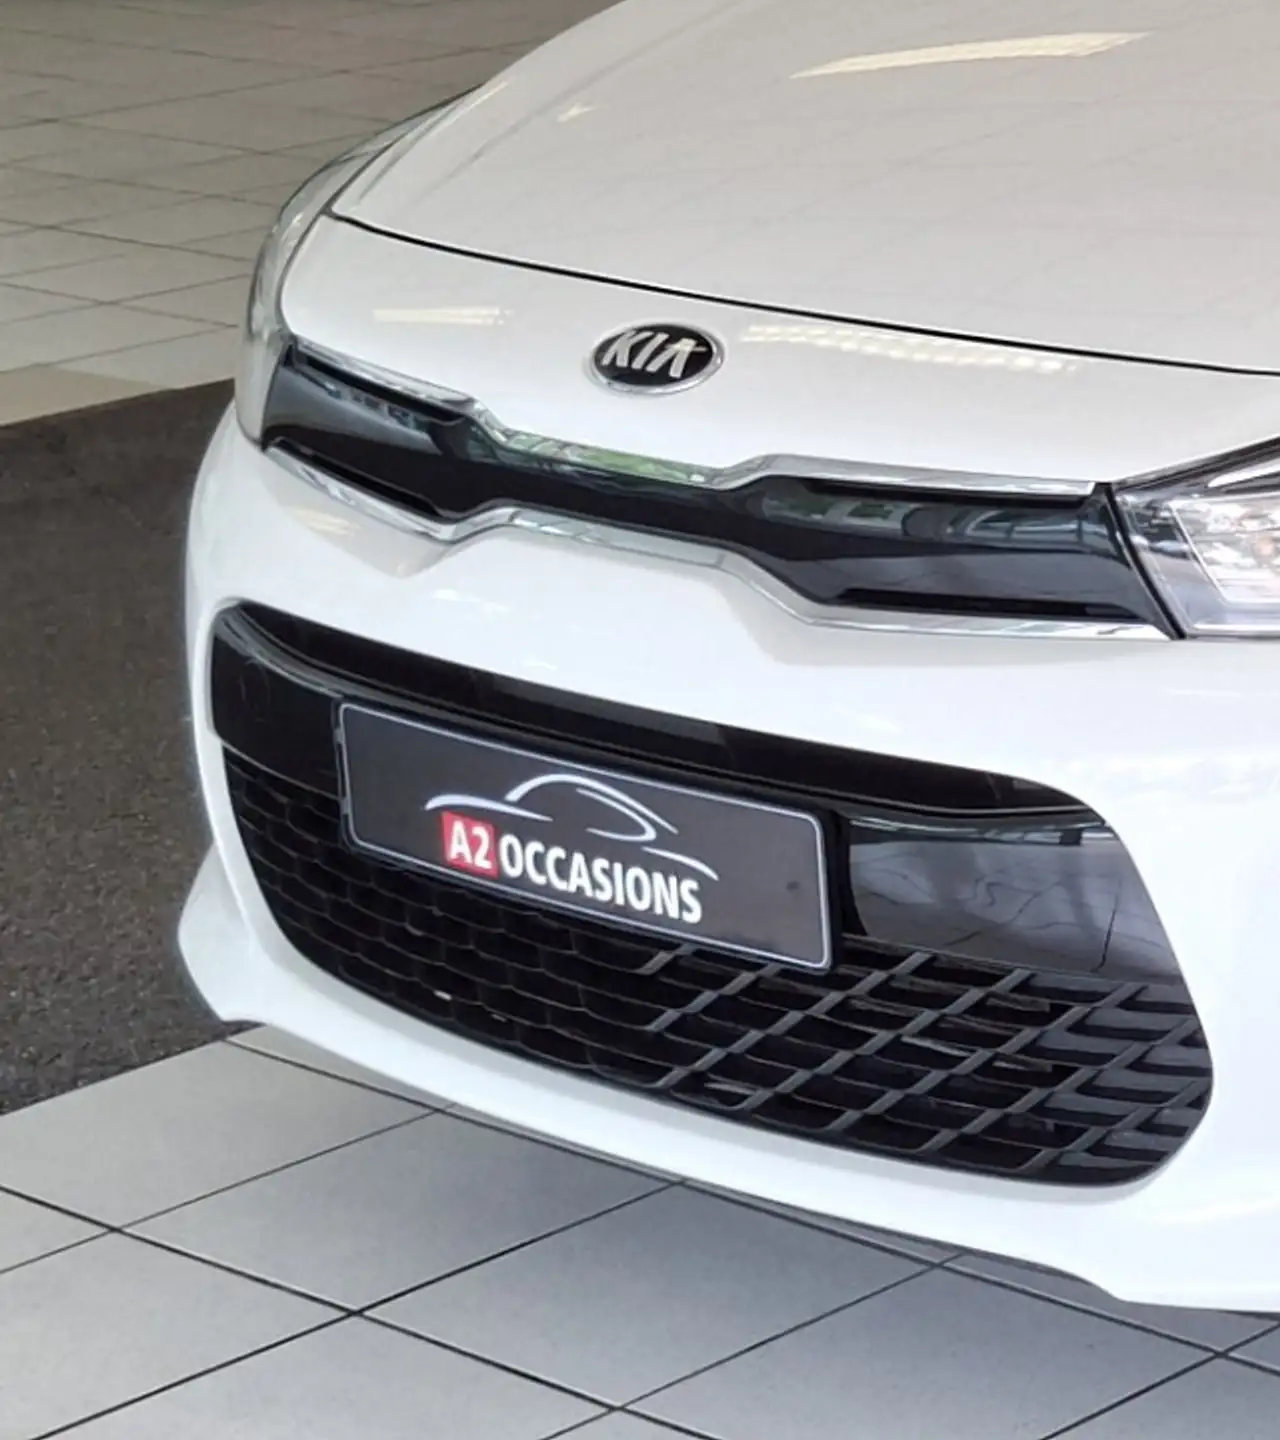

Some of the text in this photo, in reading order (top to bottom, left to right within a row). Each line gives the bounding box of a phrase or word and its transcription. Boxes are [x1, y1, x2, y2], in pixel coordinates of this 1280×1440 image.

[601, 329, 708, 379] KIA
[448, 820, 702, 925] A2 OCCASIONS
